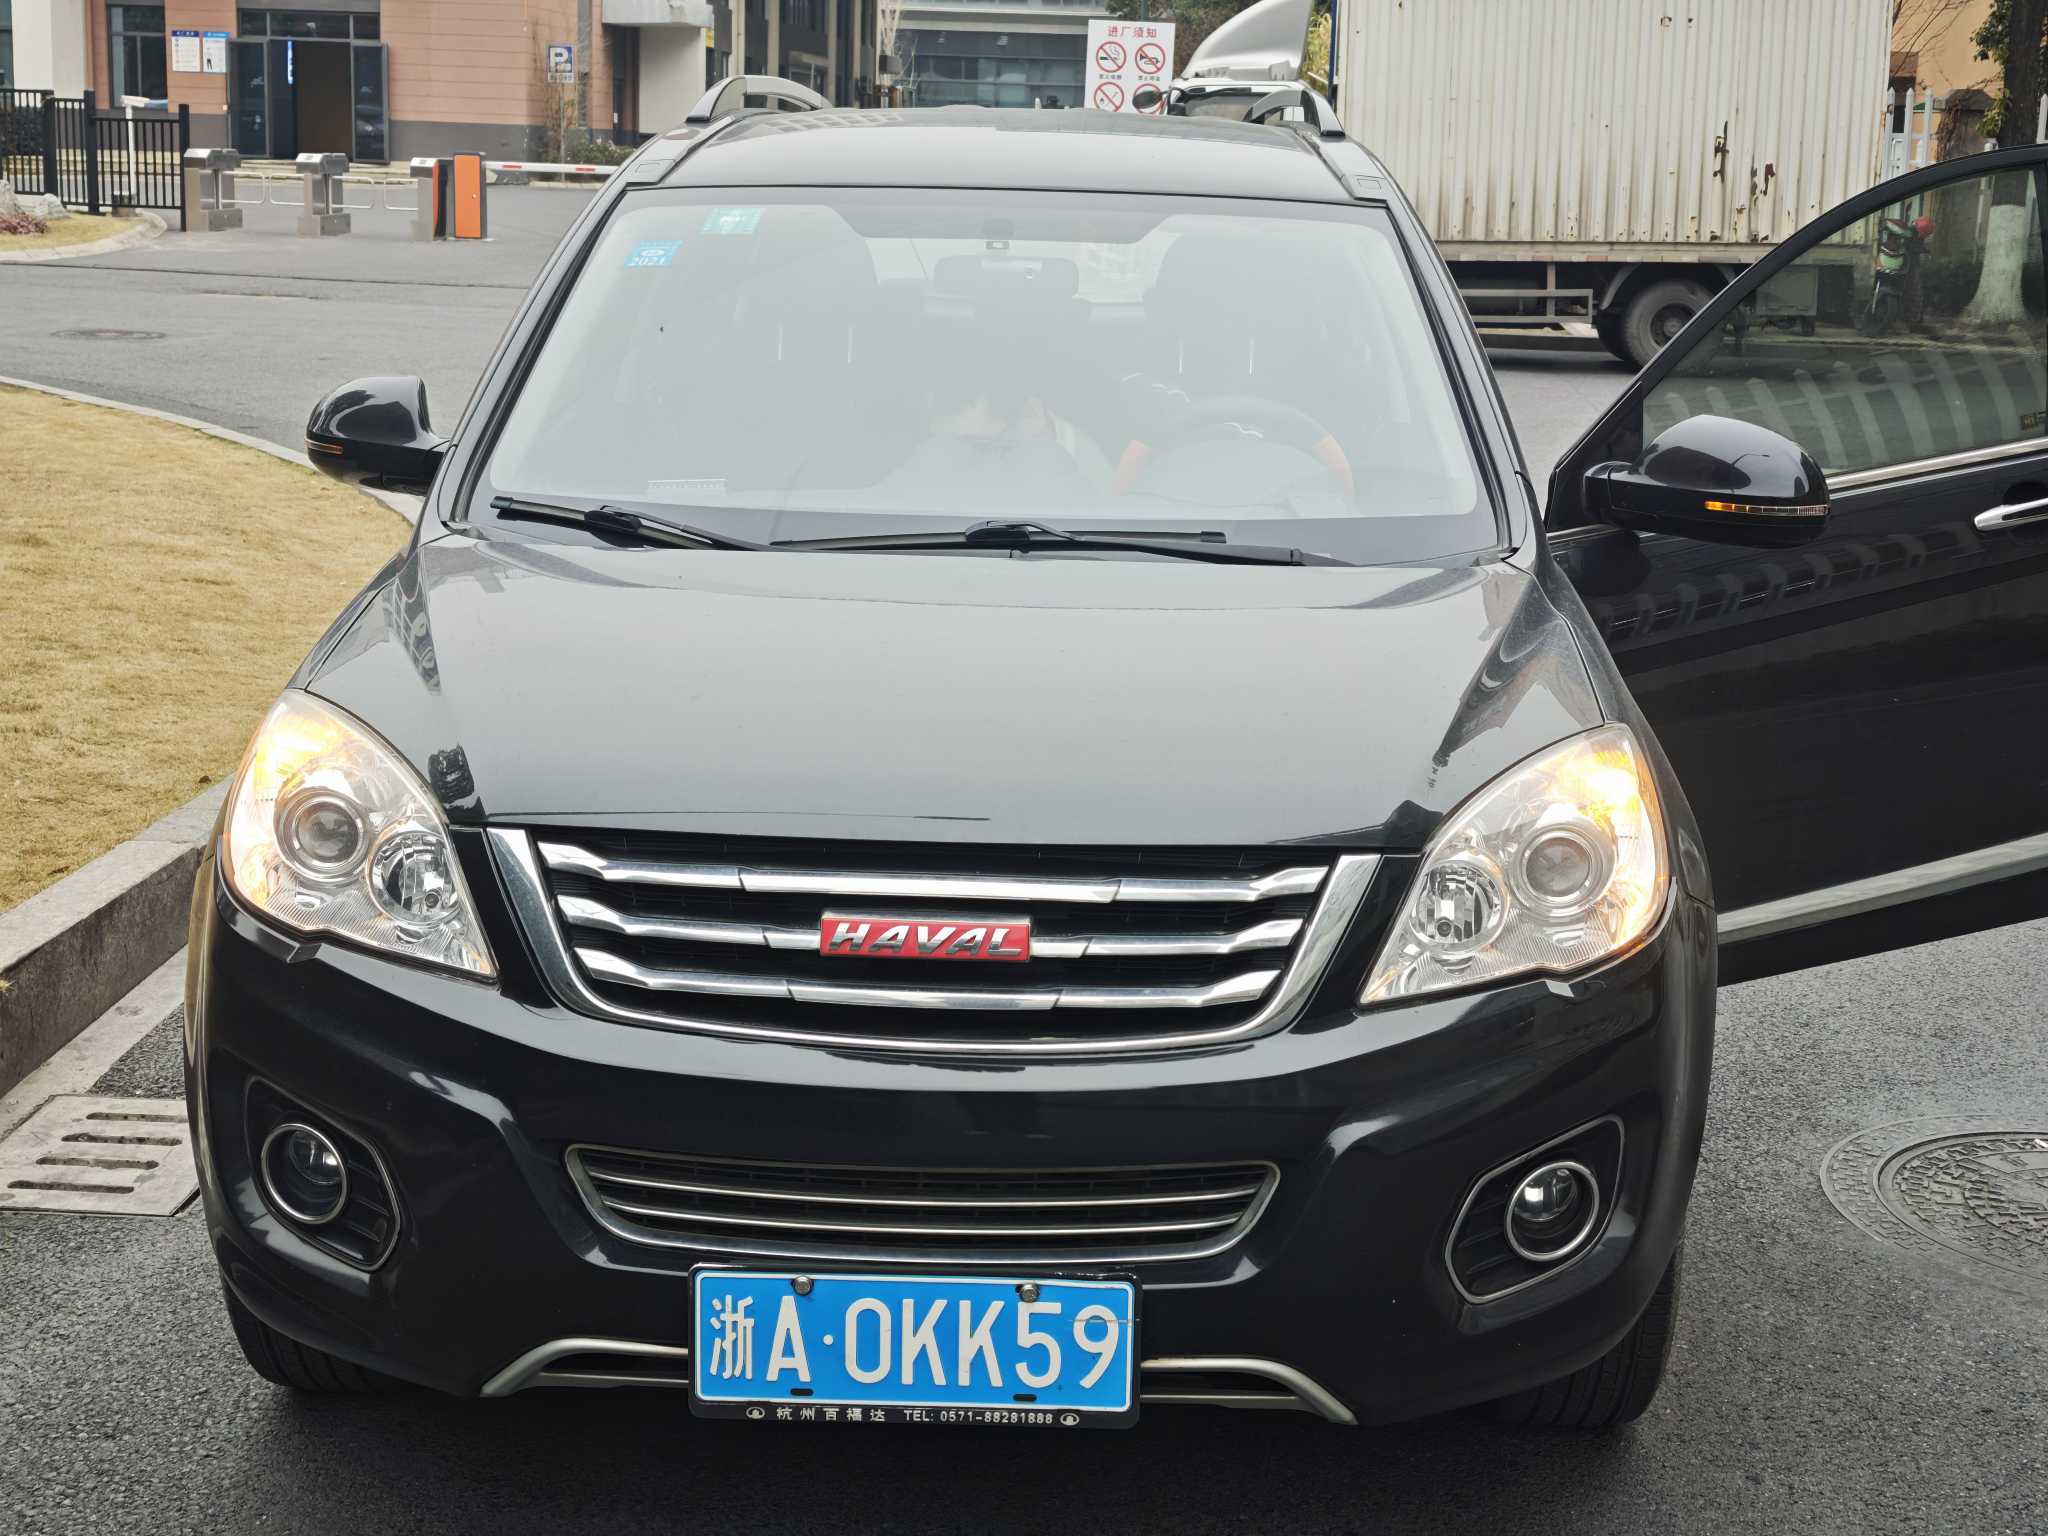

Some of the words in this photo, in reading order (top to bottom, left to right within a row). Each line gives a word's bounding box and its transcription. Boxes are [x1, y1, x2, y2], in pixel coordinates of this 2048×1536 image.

[1107, 24, 1157, 38] 进厂须知
[549, 47, 569, 72] P
[627, 256, 666, 267] 2021
[828, 922, 1022, 956] HAVAL
[776, 1407, 886, 1422] 杭州百福达
[903, 1409, 934, 1422] TEL:
